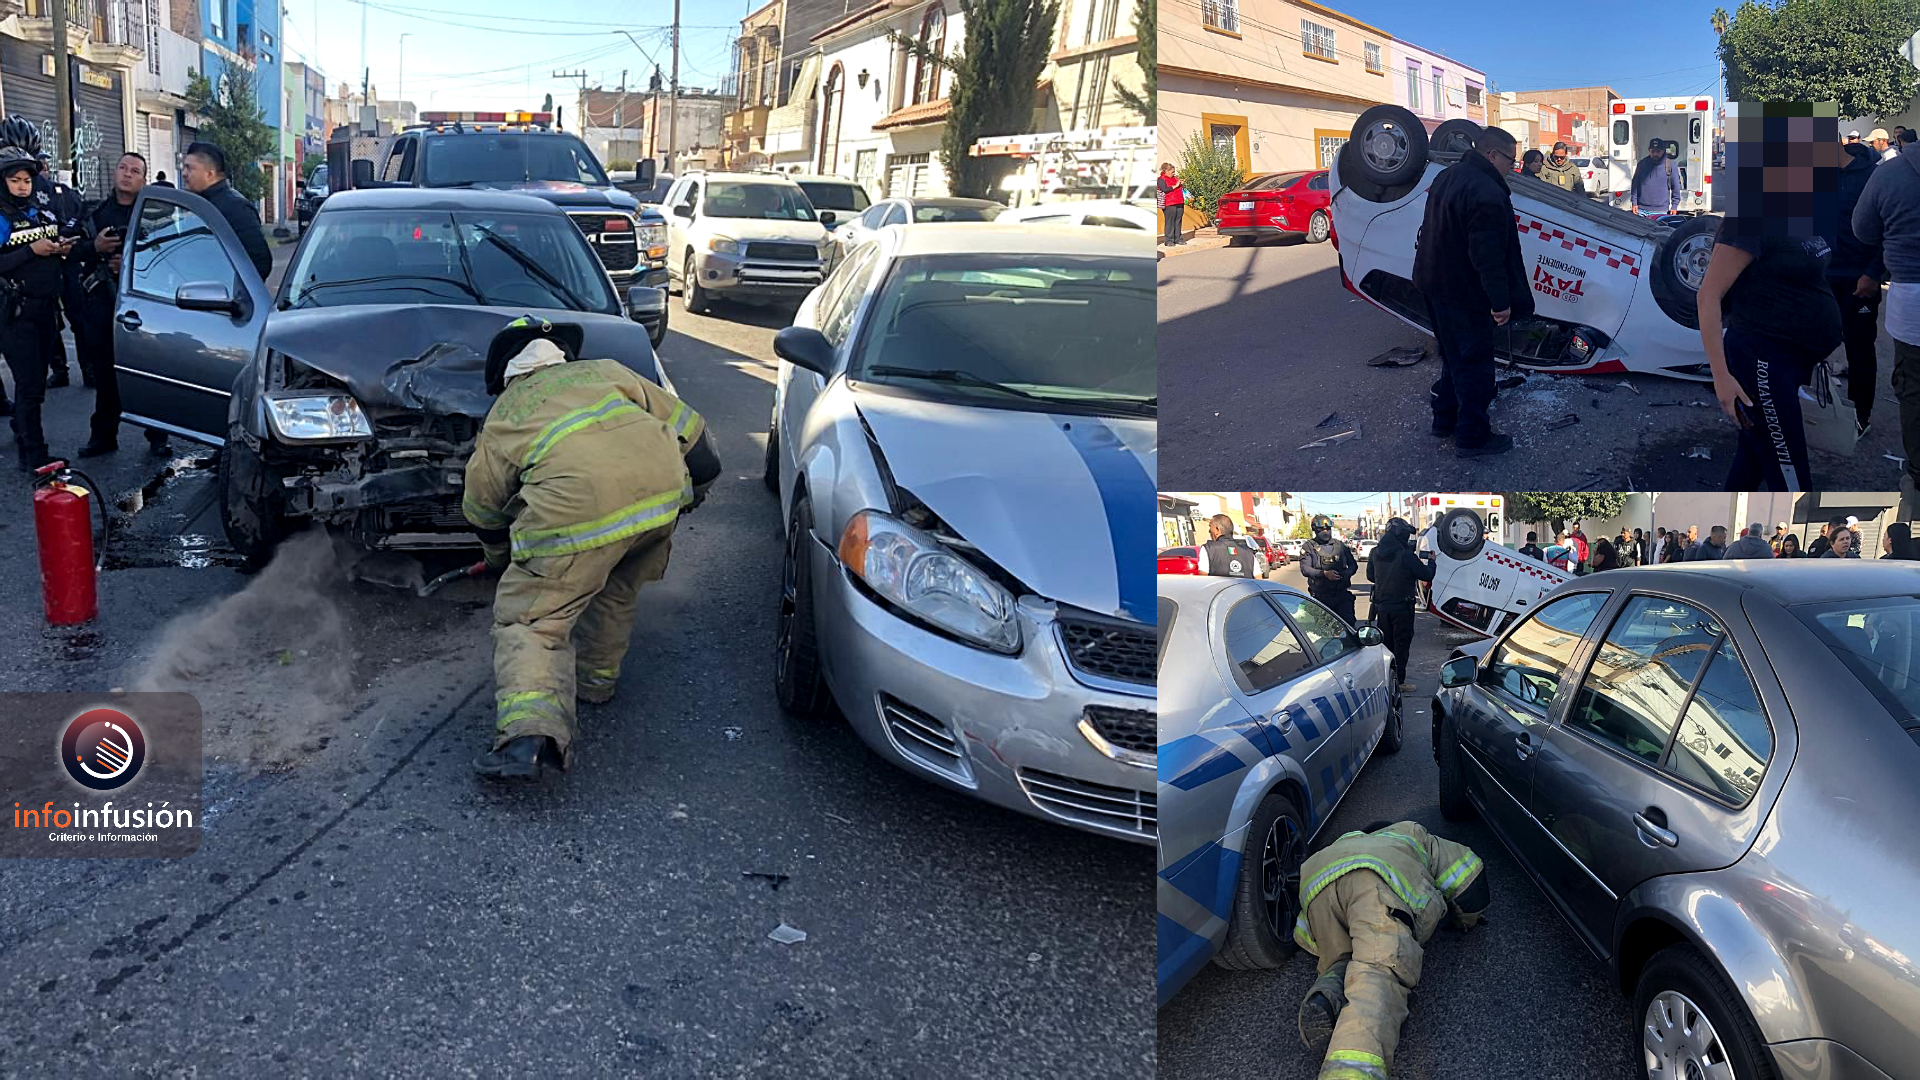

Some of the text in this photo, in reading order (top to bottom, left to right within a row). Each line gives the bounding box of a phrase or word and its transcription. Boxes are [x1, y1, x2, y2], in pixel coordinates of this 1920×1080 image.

[1537, 254, 1586, 278] INDEPENDIENTE
[1533, 265, 1584, 296] TAXI
[1534, 282, 1561, 298] DGO
